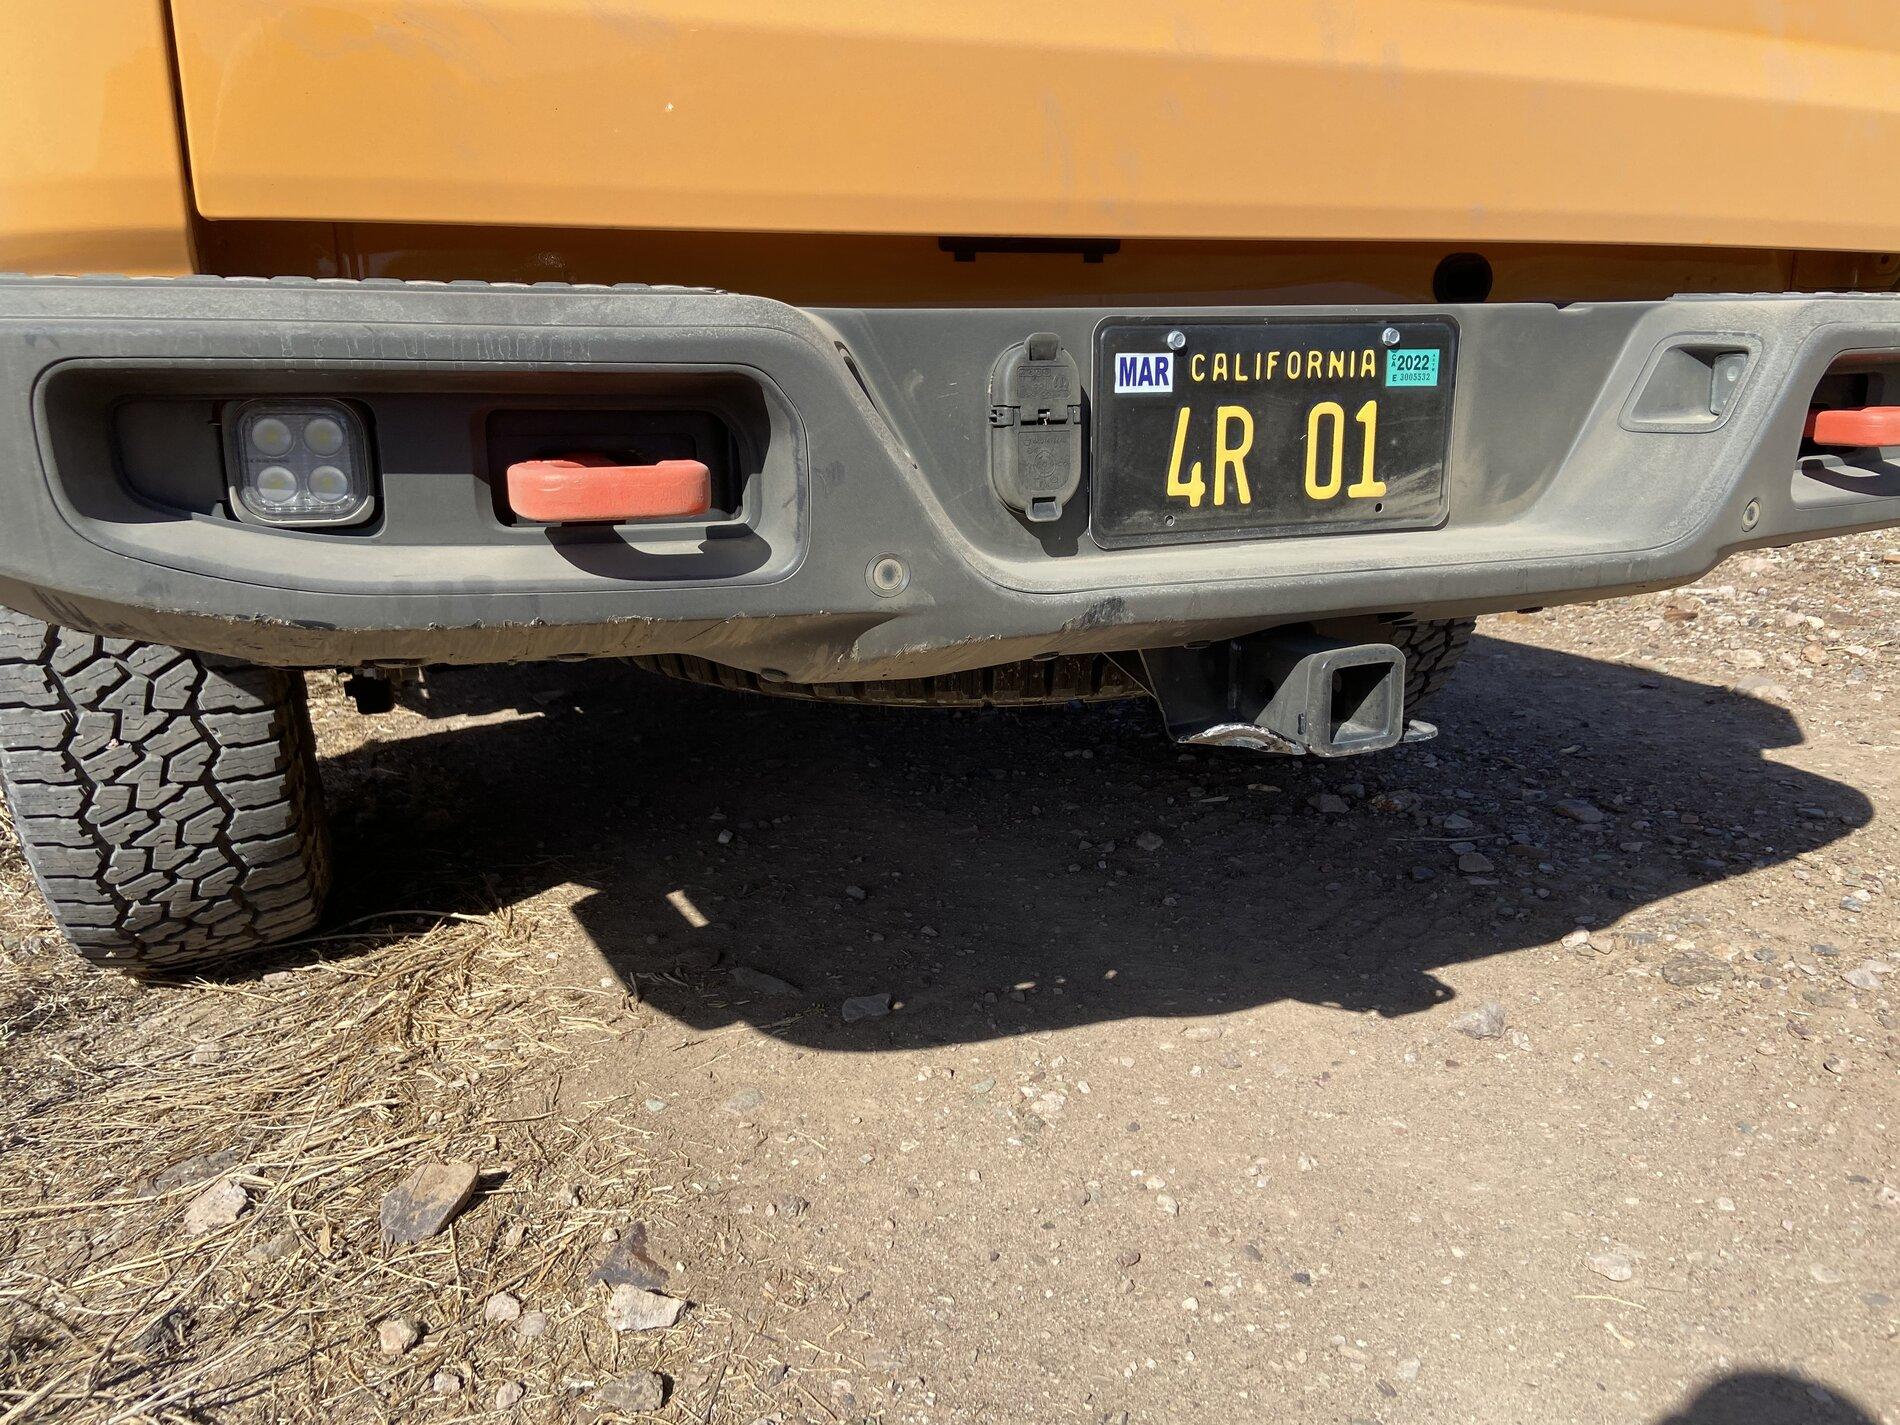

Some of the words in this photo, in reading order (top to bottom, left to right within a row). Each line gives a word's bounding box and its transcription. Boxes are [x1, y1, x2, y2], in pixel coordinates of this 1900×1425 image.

[1119, 356, 1170, 387] MAR
[1190, 349, 1376, 382] CALIFORNIA
[1392, 374, 1398, 382] E
[1397, 354, 1430, 371] 2022
[1166, 406, 1255, 508] 4R
[1304, 400, 1387, 501] 01
